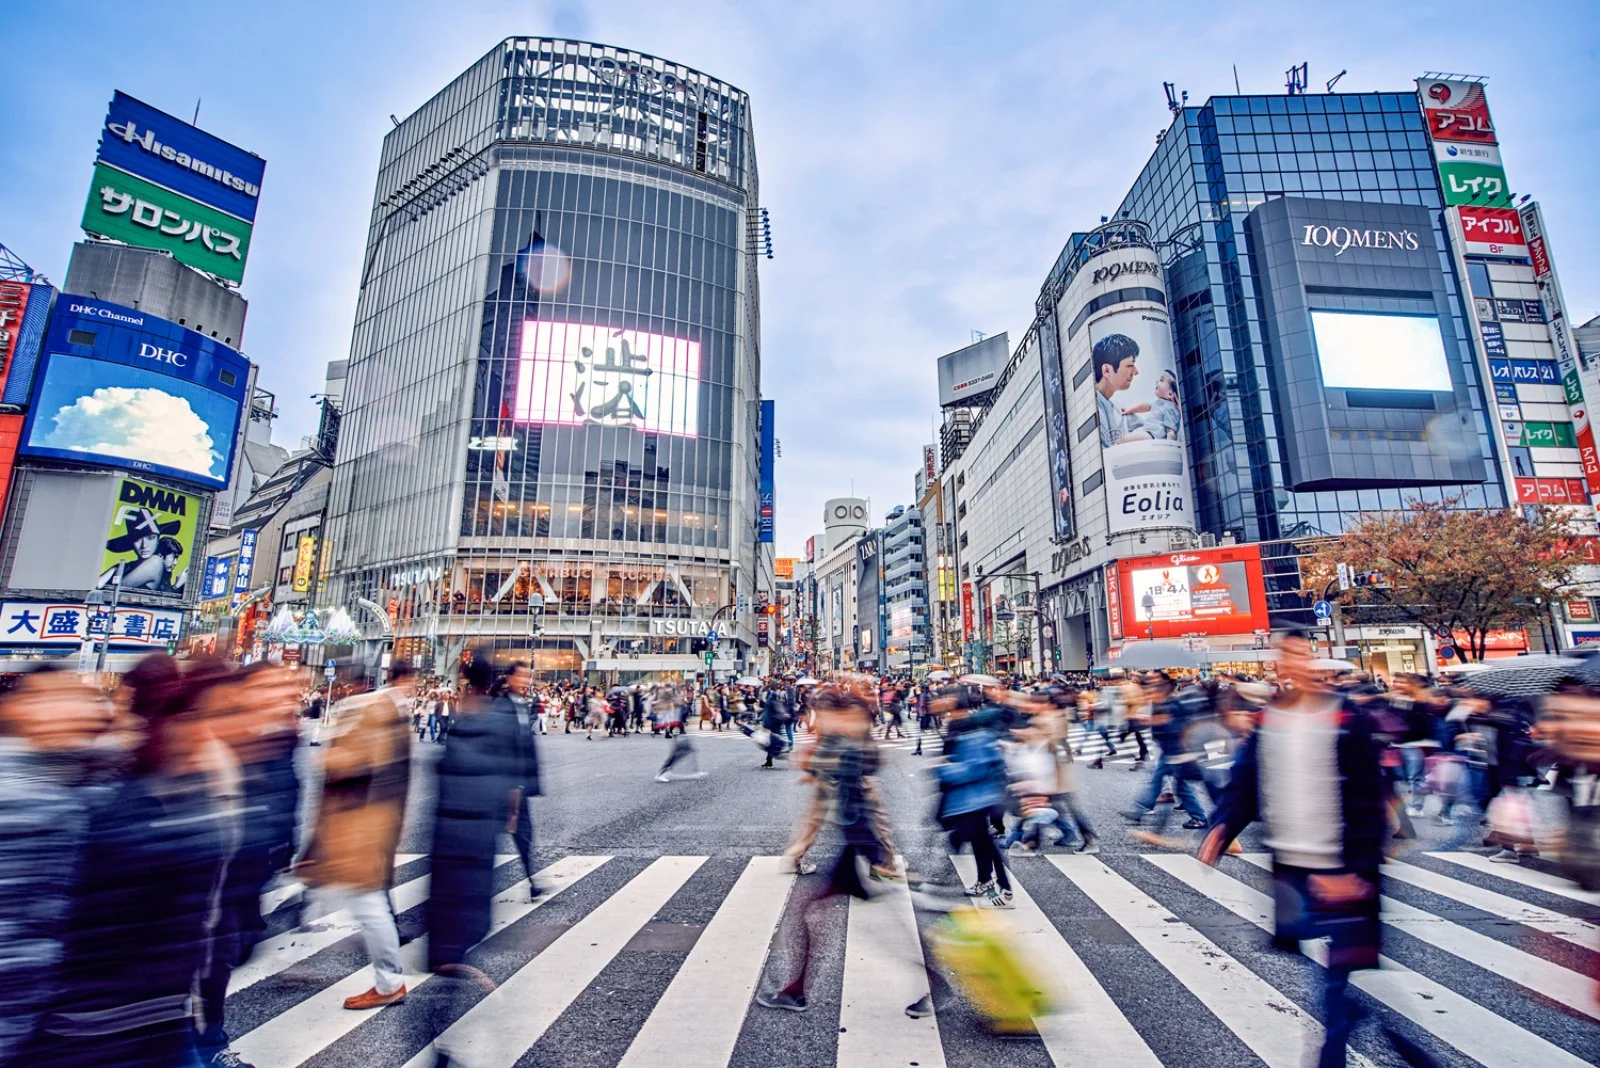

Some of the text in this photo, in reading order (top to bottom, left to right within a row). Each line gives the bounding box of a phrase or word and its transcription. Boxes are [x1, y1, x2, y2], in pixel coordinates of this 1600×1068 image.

[1436, 112, 1495, 132] アコム
[108, 121, 259, 197] Hisamitsu
[1448, 174, 1502, 196] レイク
[100, 186, 241, 260] サロンパス
[1462, 216, 1520, 234] アイフル
[1301, 224, 1419, 257] 109MEN'S
[1091, 261, 1159, 285] 109MEN'S
[70, 303, 144, 326] DHC Channel
[139, 343, 188, 368] DHC
[1566, 377, 1580, 401] レイク
[1526, 429, 1553, 440] レイク
[1582, 446, 1599, 474] アコム
[120, 480, 186, 516] DMM
[1122, 490, 1184, 514] Eolia
[1521, 483, 1566, 498] アコム
[114, 505, 161, 534] FX
[860, 541, 877, 560] ZARA
[1170, 554, 1201, 566] Glico
[7, 610, 176, 639] 大盛堂書店
[653, 619, 728, 636] TSUTAYA
